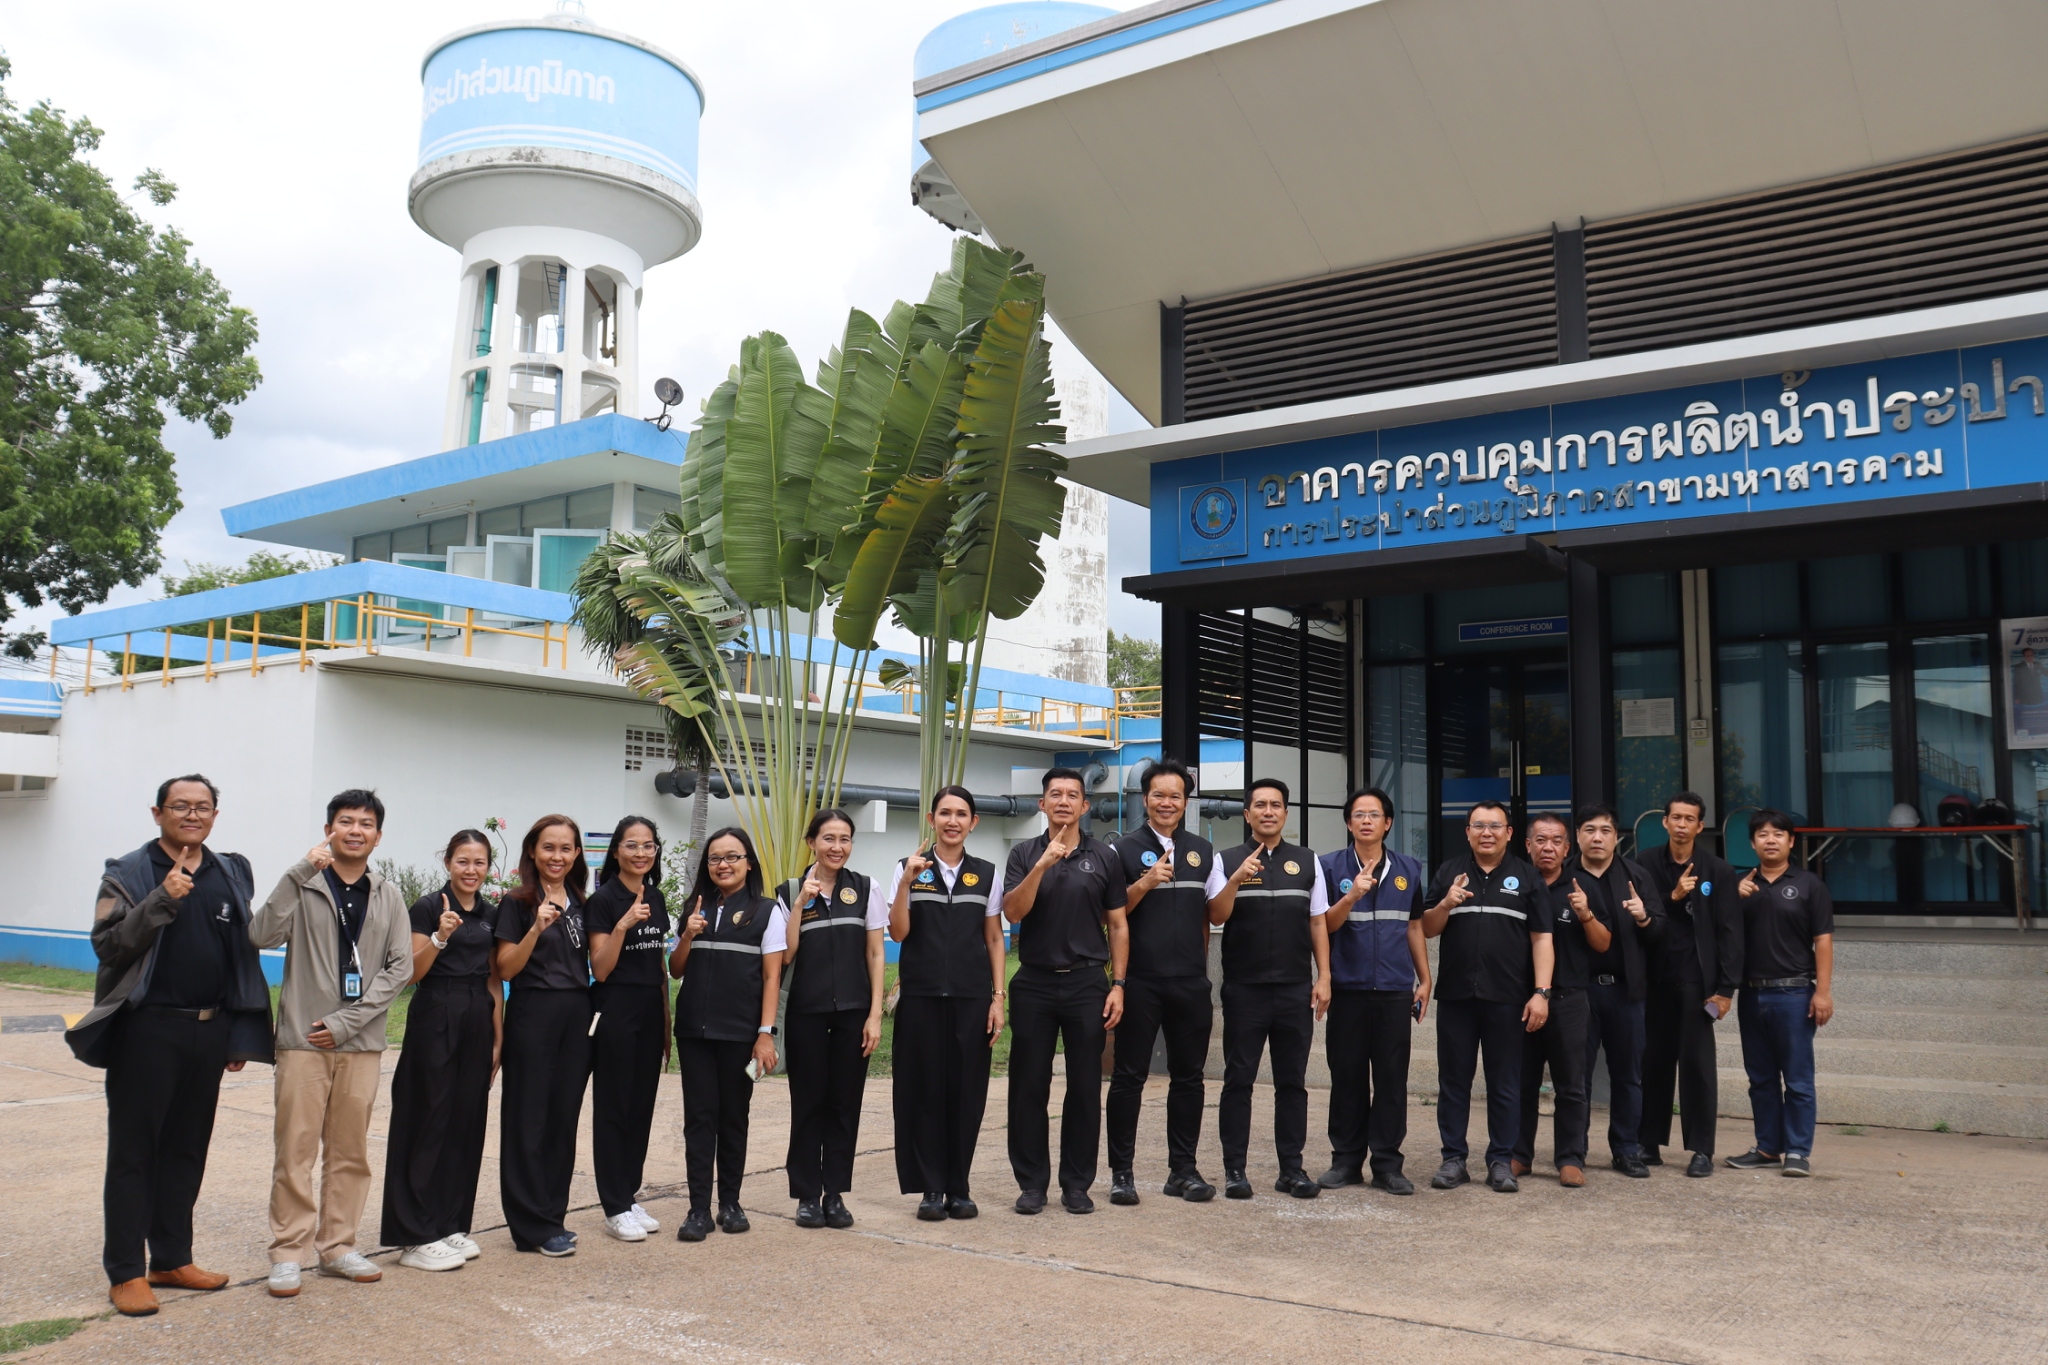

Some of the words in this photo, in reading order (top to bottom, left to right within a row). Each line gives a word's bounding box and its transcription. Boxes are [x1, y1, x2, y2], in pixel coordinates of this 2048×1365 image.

[1258, 357, 2046, 507] อาคารควบคุมการผลิตน้ำประปา
[1480, 624, 1529, 635] CONFERENCE
[1530, 622, 1553, 631] ROOM
[2011, 628, 2026, 646] 7
